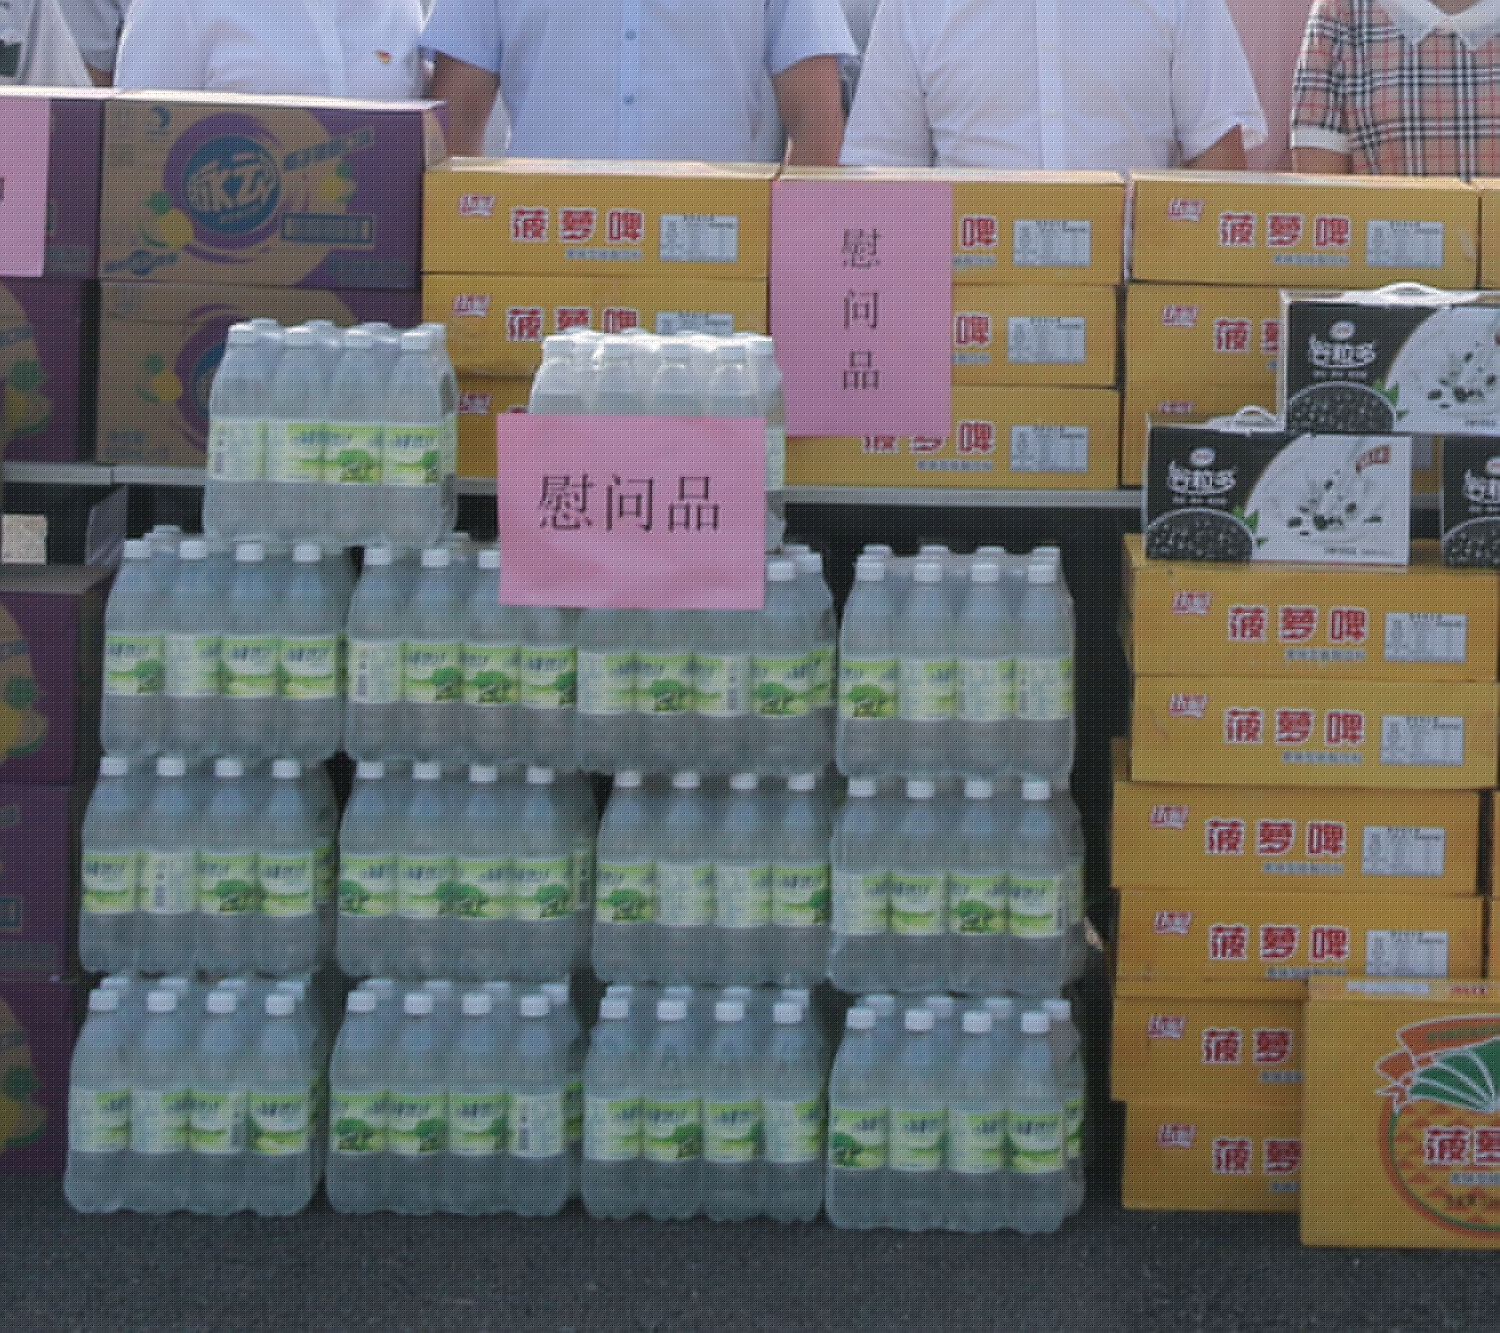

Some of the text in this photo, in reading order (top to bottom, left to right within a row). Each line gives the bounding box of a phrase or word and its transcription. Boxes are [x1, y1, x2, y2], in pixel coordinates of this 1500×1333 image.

[510, 207, 645, 244] 菠萝啤
[1218, 212, 1352, 247] 菠萝啤
[840, 227, 882, 392] 慰问品
[537, 474, 722, 534] 慰问品
[1228, 604, 1368, 643] 菠萝啤
[1224, 708, 1365, 746] 菠萝啤
[1205, 819, 1347, 857] 菠萝啤
[1208, 923, 1350, 962] 菠萝啤
[1202, 1028, 1293, 1065] 菠萝
[1212, 1136, 1300, 1174] 菠萝
